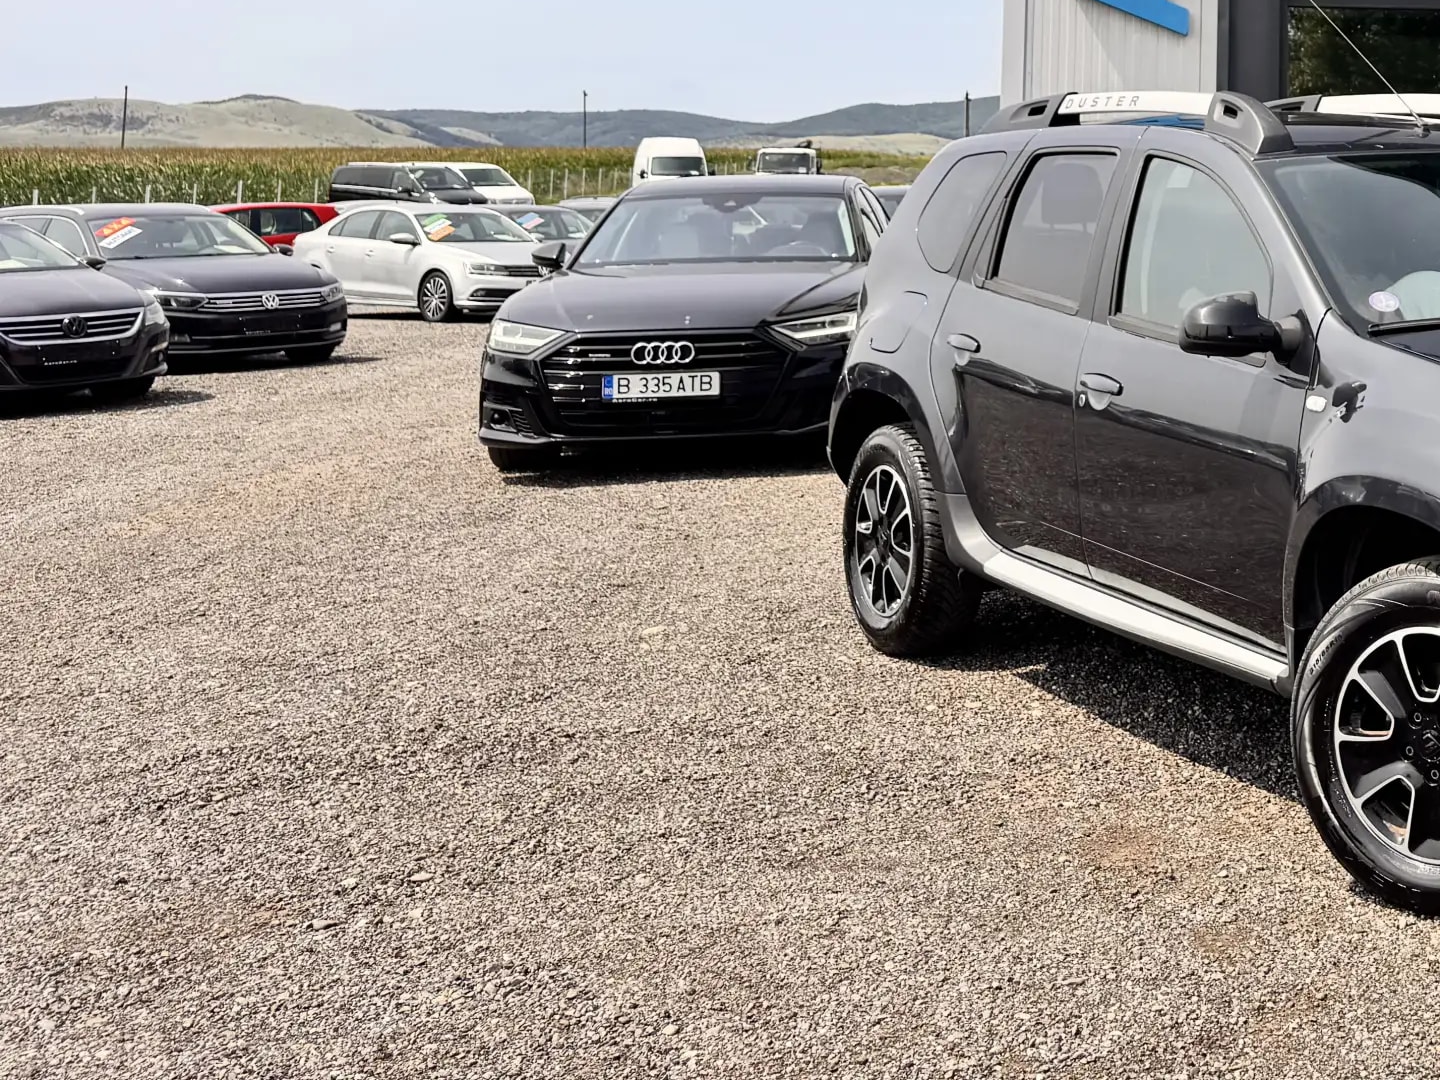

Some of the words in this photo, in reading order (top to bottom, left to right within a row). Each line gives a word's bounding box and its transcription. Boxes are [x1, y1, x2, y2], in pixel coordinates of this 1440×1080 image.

[1065, 95, 1140, 109] DUSTER
[617, 377, 631, 394] B
[639, 376, 673, 394] 335
[676, 374, 713, 393] ATB
